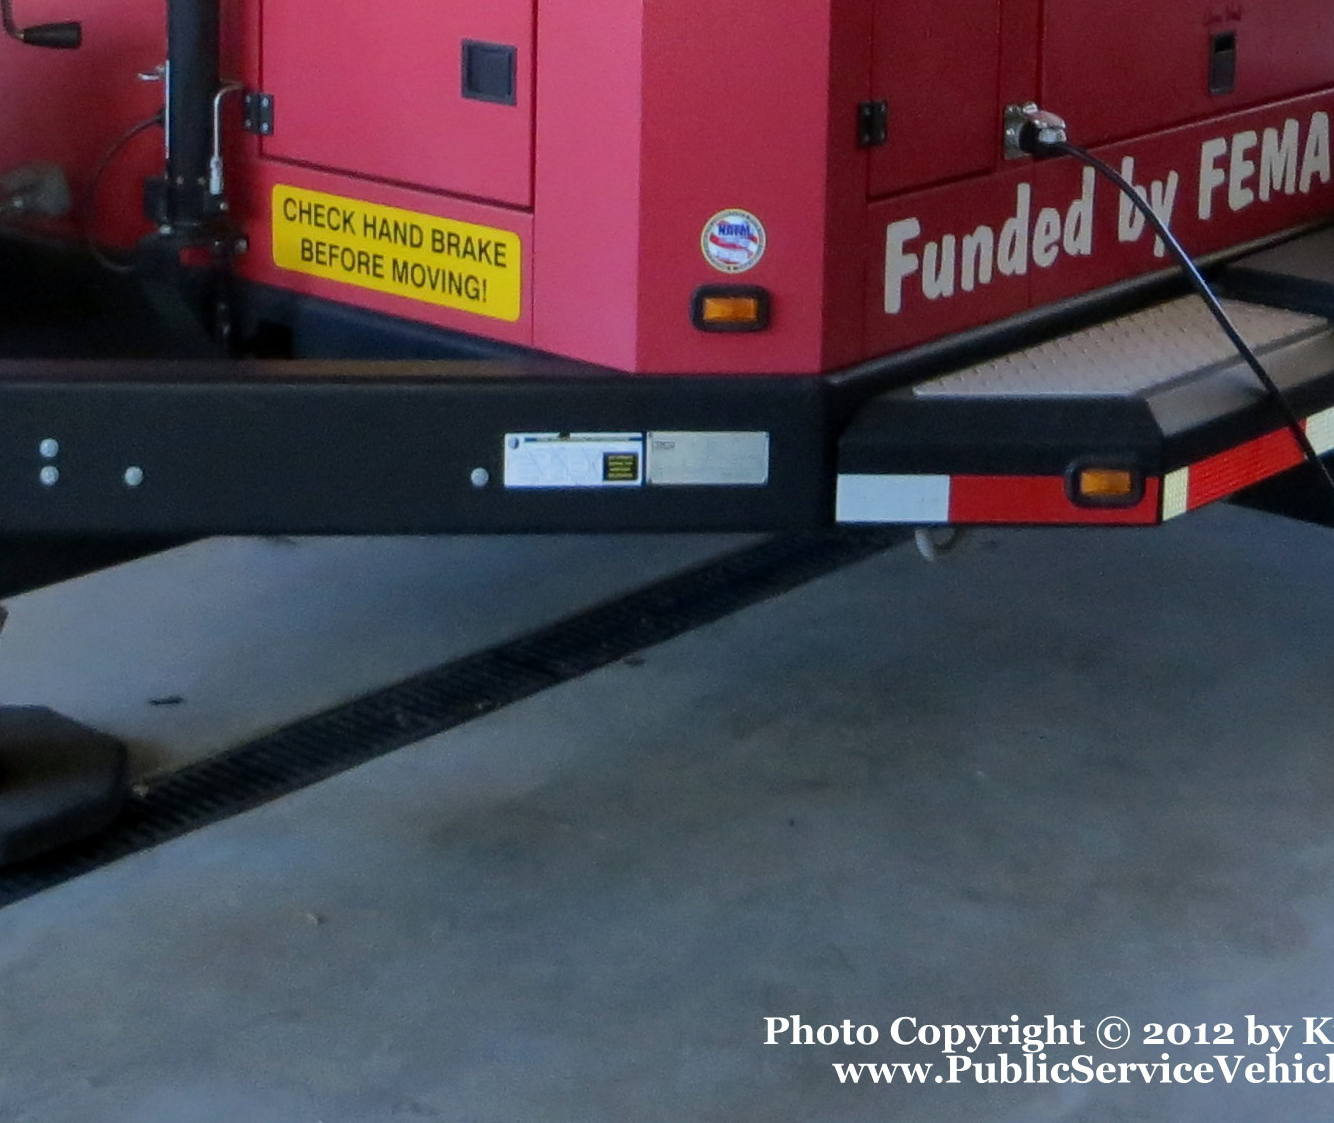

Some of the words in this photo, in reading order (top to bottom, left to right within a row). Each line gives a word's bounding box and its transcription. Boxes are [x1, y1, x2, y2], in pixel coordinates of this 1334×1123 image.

[283, 197, 356, 234] CHECK
[363, 214, 424, 249] HAND
[431, 228, 507, 269] BRAKE
[884, 166, 1095, 315] Funded
[1118, 156, 1179, 258] by
[1198, 111, 1331, 220] FEMA
[301, 238, 385, 279] BEFORE
[392, 258, 487, 303] MOVING!
